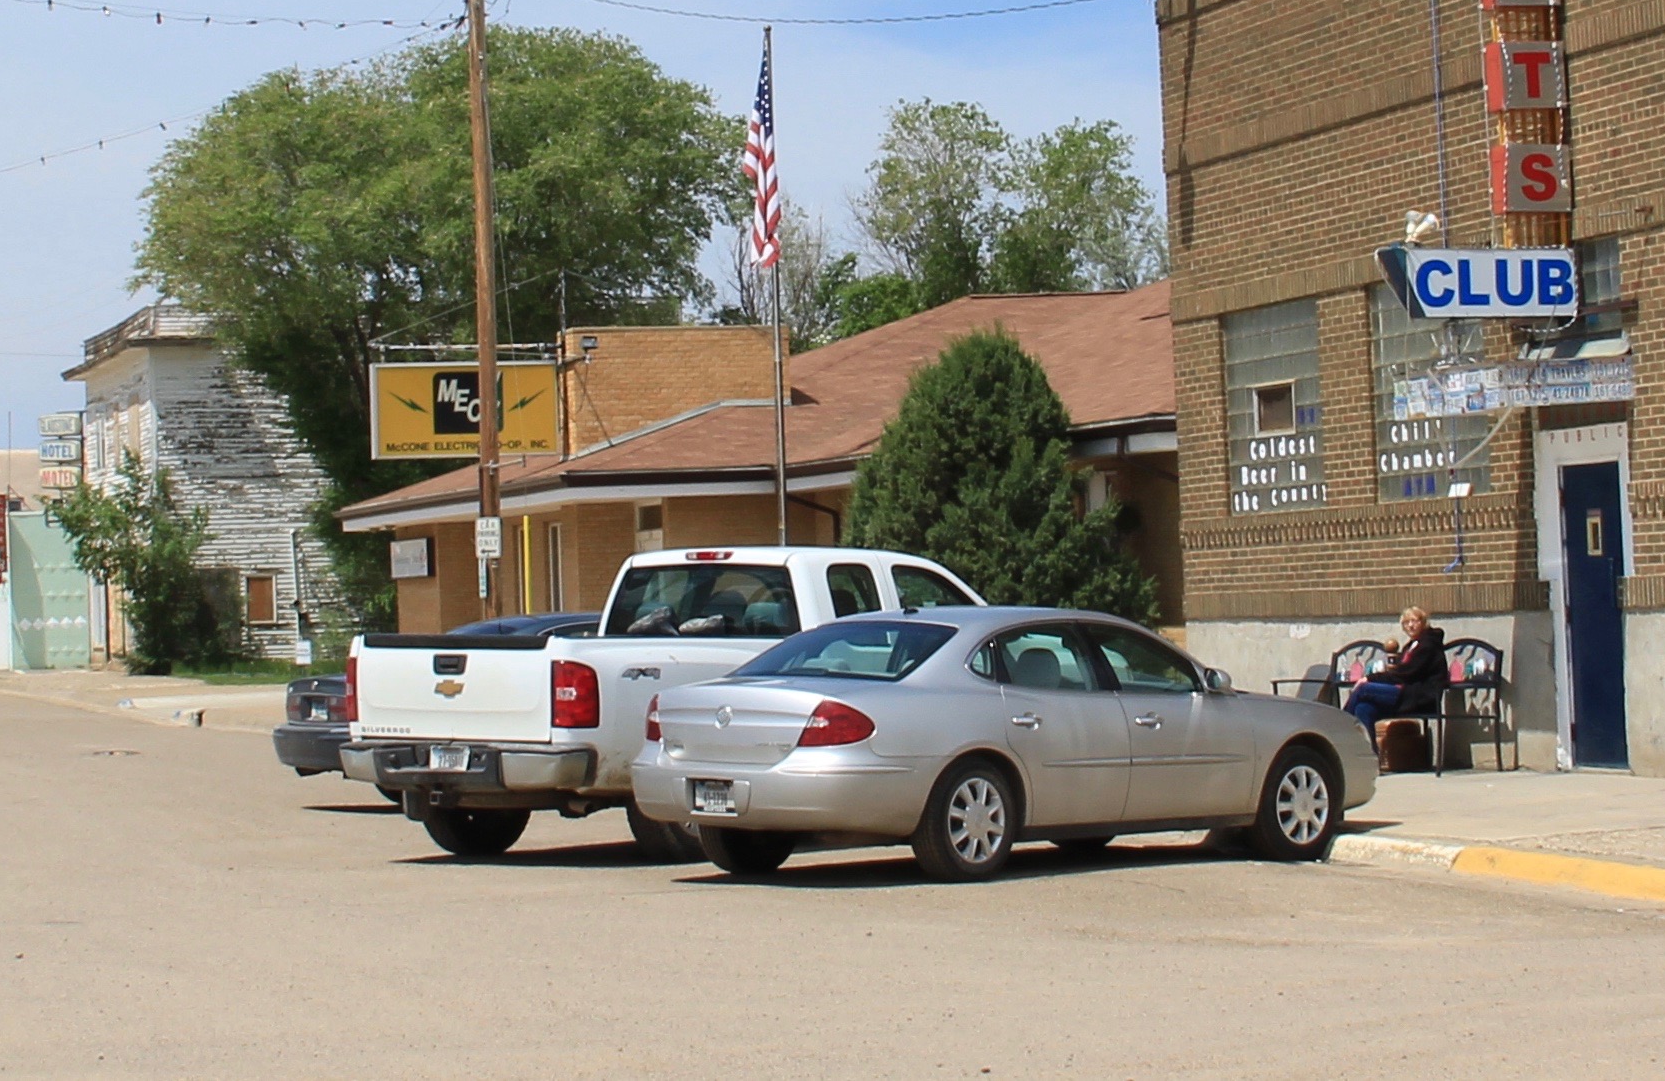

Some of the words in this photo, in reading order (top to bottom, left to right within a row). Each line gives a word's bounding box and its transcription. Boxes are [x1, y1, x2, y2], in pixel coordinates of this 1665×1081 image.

[1415, 257, 1575, 308] CLUB
[1549, 425, 1623, 444] PUBLIC
[41, 444, 73, 458] HOTEL
[386, 441, 430, 452] McCONE
[1250, 435, 1315, 461] Coldest
[1380, 448, 1455, 472] Chamber
[41, 470, 74, 486] MOTEL
[1241, 466, 1276, 485] Beer
[1291, 460, 1307, 481] in
[1234, 491, 1259, 512] the
[1271, 484, 1327, 507] County
[478, 539, 498, 548] ONLY
[361, 726, 411, 734] SILVERADO
